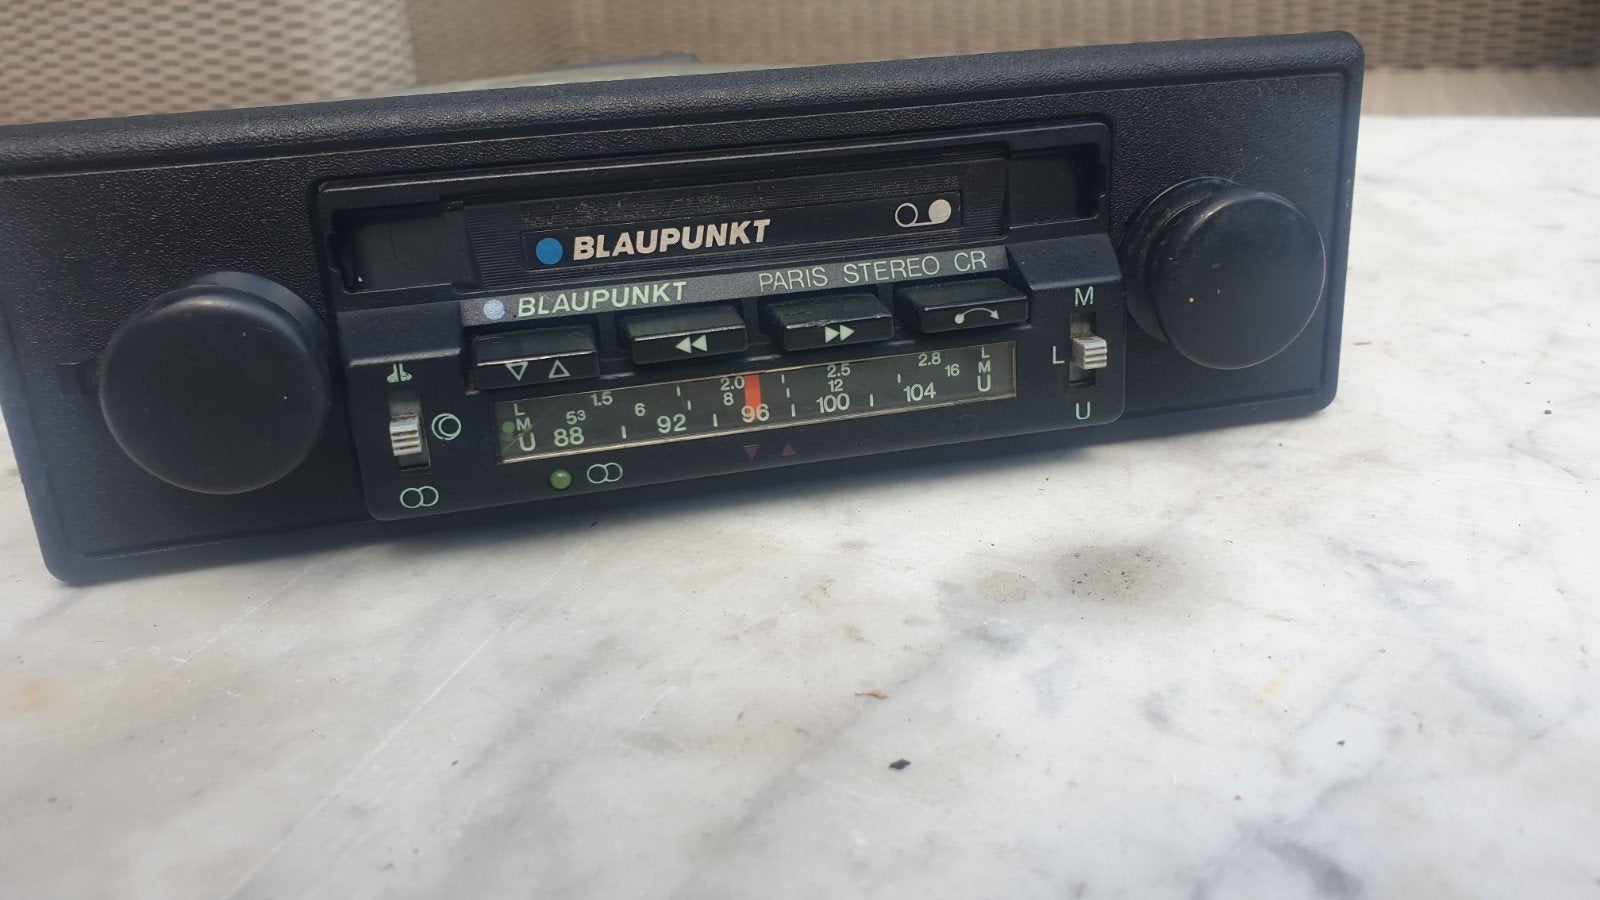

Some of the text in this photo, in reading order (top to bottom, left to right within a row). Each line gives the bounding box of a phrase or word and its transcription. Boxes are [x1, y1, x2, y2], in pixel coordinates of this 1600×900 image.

[572, 218, 771, 261] BLAUPUNKT
[758, 249, 988, 293] PARIS STEREO CR
[517, 281, 688, 318] BLAUPUNKT
[1075, 285, 1094, 307] M
[980, 346, 990, 359] L
[1052, 345, 1066, 365] L
[978, 360, 991, 373] M
[590, 352, 942, 407] 1.5 2.0 2.5 2.8
[976, 374, 992, 393] U
[565, 364, 960, 425] 53 6 8 12 16
[514, 402, 525, 416] L
[553, 382, 937, 447] 88 92 96 100 104
[1075, 401, 1091, 420] U
[516, 416, 531, 431] M
[519, 431, 536, 451] U
